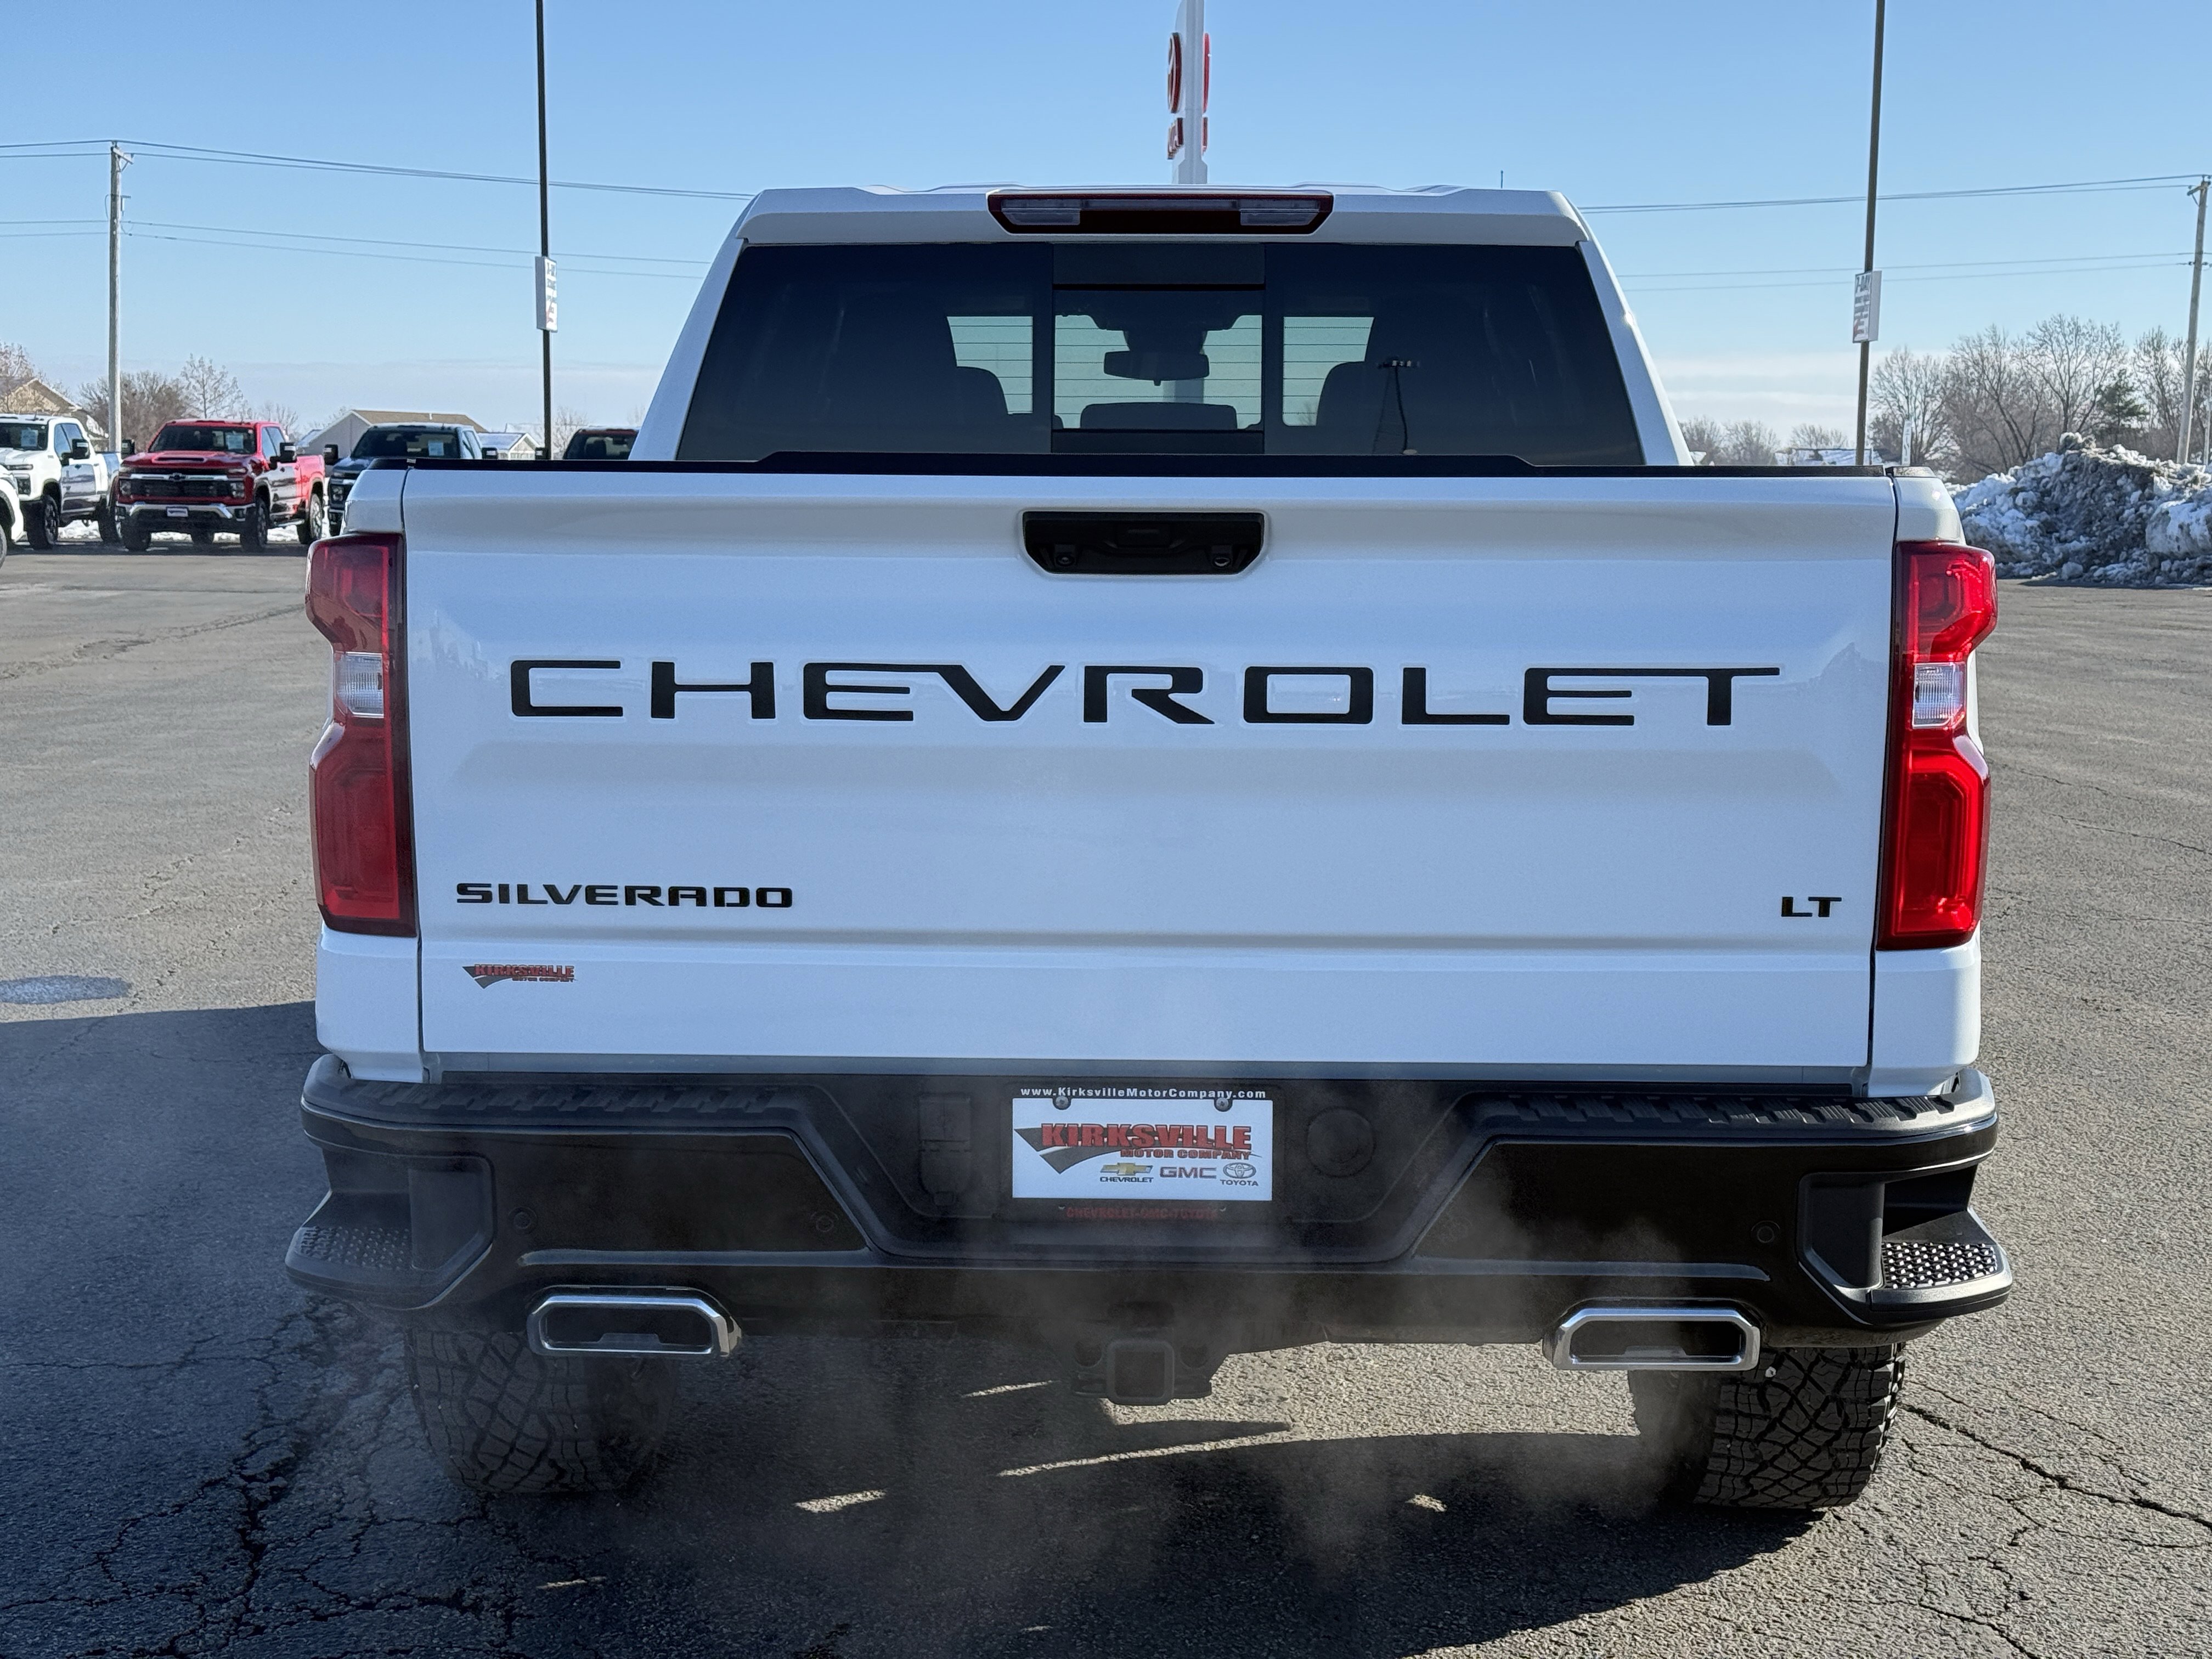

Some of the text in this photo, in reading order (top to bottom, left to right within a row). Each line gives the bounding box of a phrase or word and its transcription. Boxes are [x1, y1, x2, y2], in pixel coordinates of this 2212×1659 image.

[511, 660, 1780, 726] CHEVROLET
[456, 883, 793, 907] SILVERADO
[1781, 896, 1842, 917] LT
[474, 964, 575, 978] KIRKSVILLE
[1020, 1087, 1266, 1099] www.KirksvilleMotorCompany.com
[1041, 1123, 1252, 1150] KIRKSVILLE
[1120, 1149, 1251, 1160] MOTOR COMPANY
[1159, 1166, 1217, 1180] GMC
